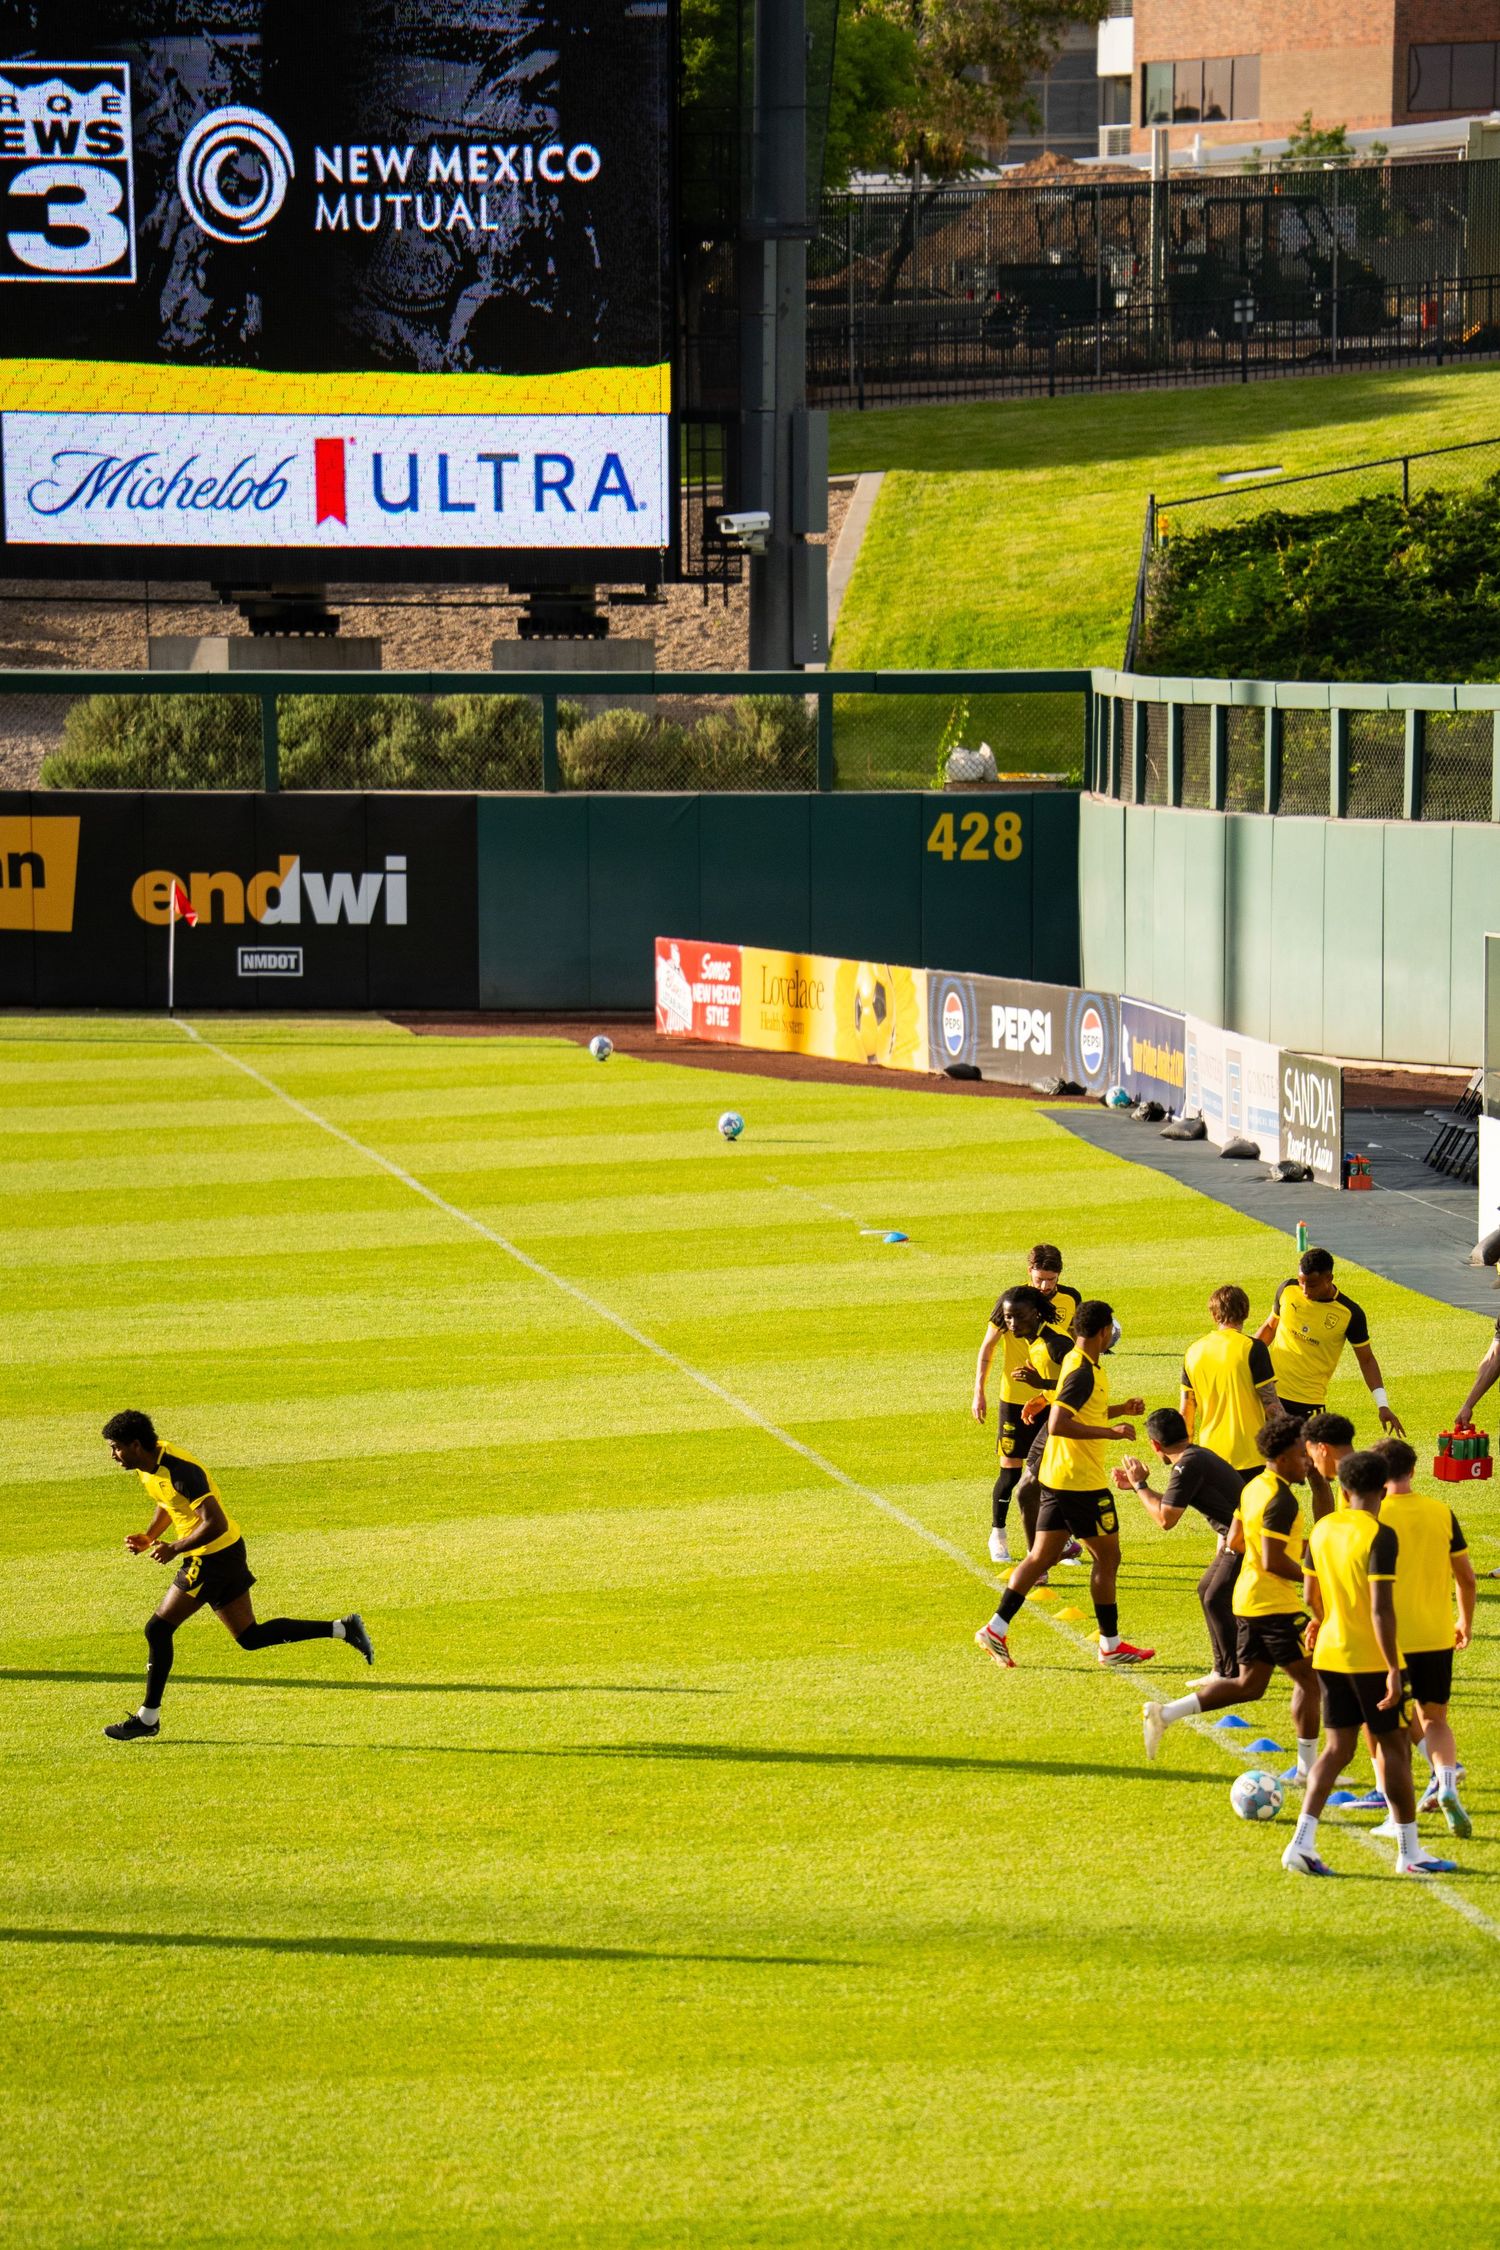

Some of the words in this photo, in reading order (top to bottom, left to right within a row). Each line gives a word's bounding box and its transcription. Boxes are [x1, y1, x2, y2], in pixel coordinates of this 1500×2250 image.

[314, 145, 416, 184] NEW
[427, 143, 601, 183] MEXICO
[7, 162, 129, 273] 3
[314, 195, 500, 232] MUTUAL
[28, 450, 298, 516] Michelob
[372, 452, 640, 513] ULTRA
[927, 811, 1023, 861] 428
[0, 851, 46, 889] n
[131, 854, 408, 926] endwi
[243, 953, 298, 971] NMDOT
[692, 983, 712, 1004] NEW
[712, 984, 742, 1007] MEXICO
[761, 965, 825, 1011] Lovelace
[706, 1005, 730, 1028] STYLE
[760, 1011, 781, 1032] Health
[782, 1017, 805, 1036] System
[944, 1016, 963, 1032] PEPSI
[991, 1005, 1052, 1056] PEPSI
[1082, 1034, 1101, 1049] PEPSI
[1283, 1067, 1337, 1138] SANDIA
[1471, 1461, 1482, 1478] G
